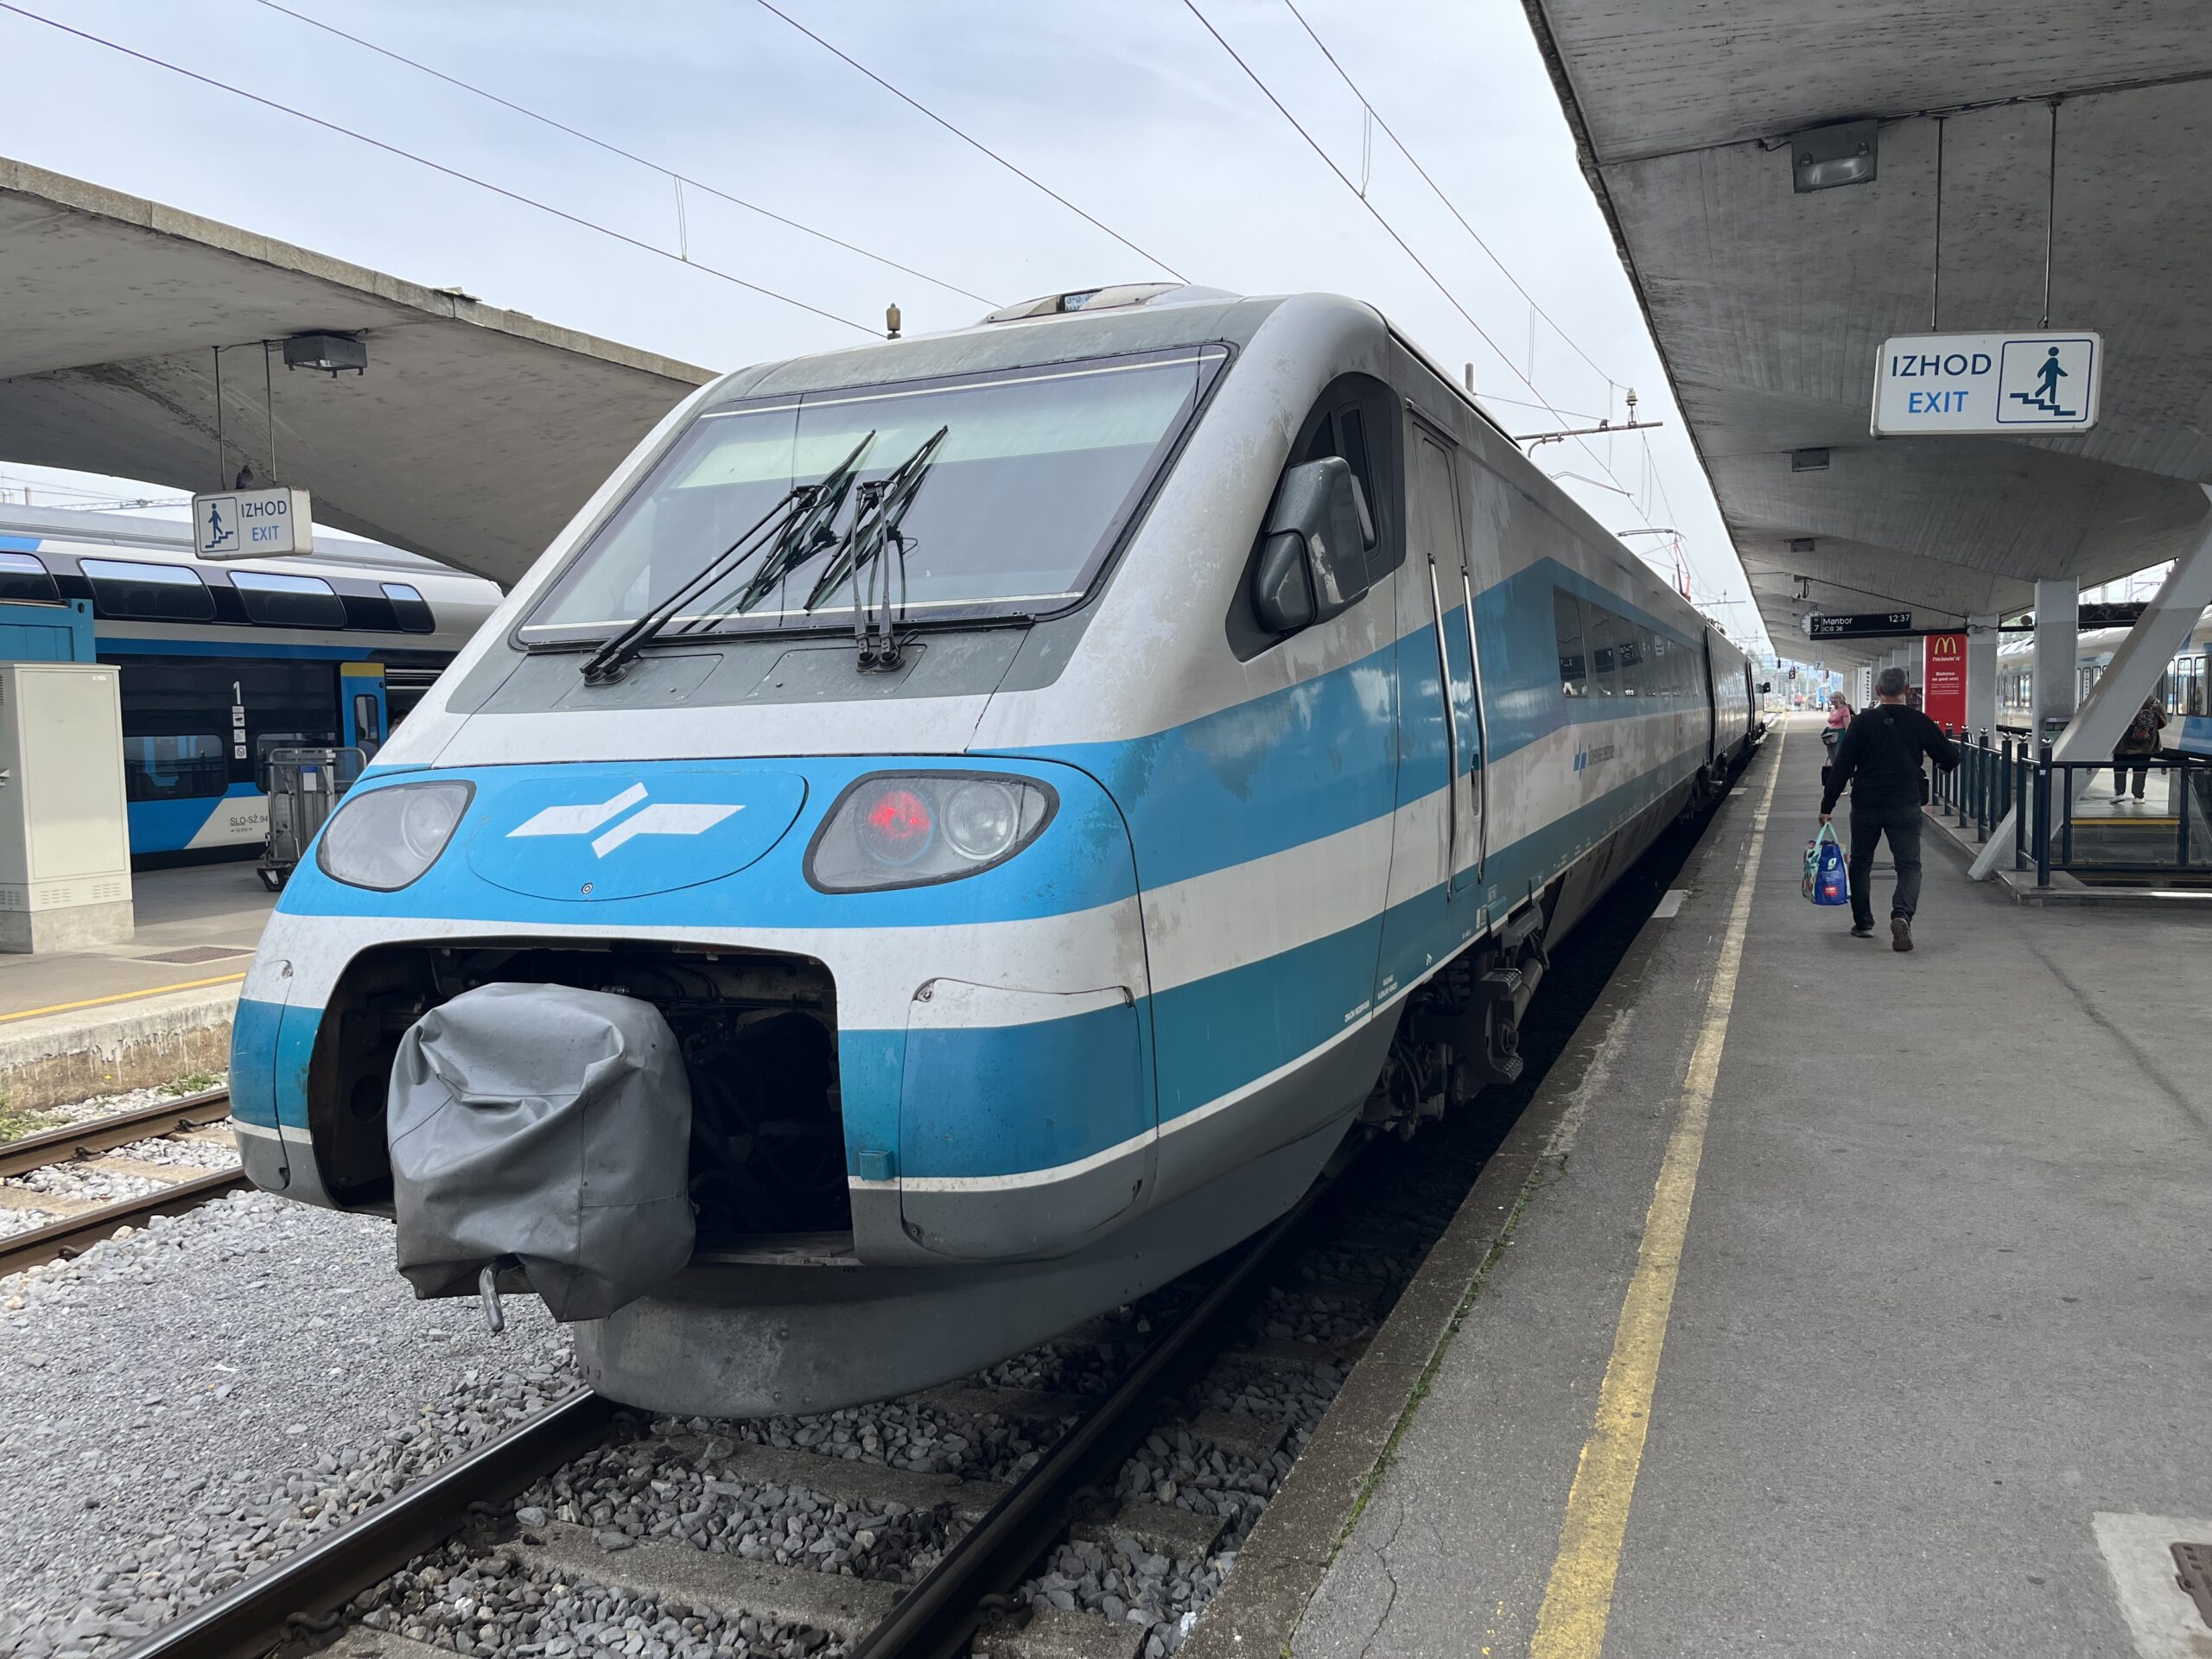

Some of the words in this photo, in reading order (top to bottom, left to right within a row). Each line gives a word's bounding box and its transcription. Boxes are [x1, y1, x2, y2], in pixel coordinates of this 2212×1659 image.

[1891, 353, 1992, 377] IZHOD
[1908, 391, 1969, 414] EXIT
[241, 500, 287, 518] IZHOD
[251, 525, 280, 542] EXIT
[233, 681, 241, 705] 1
